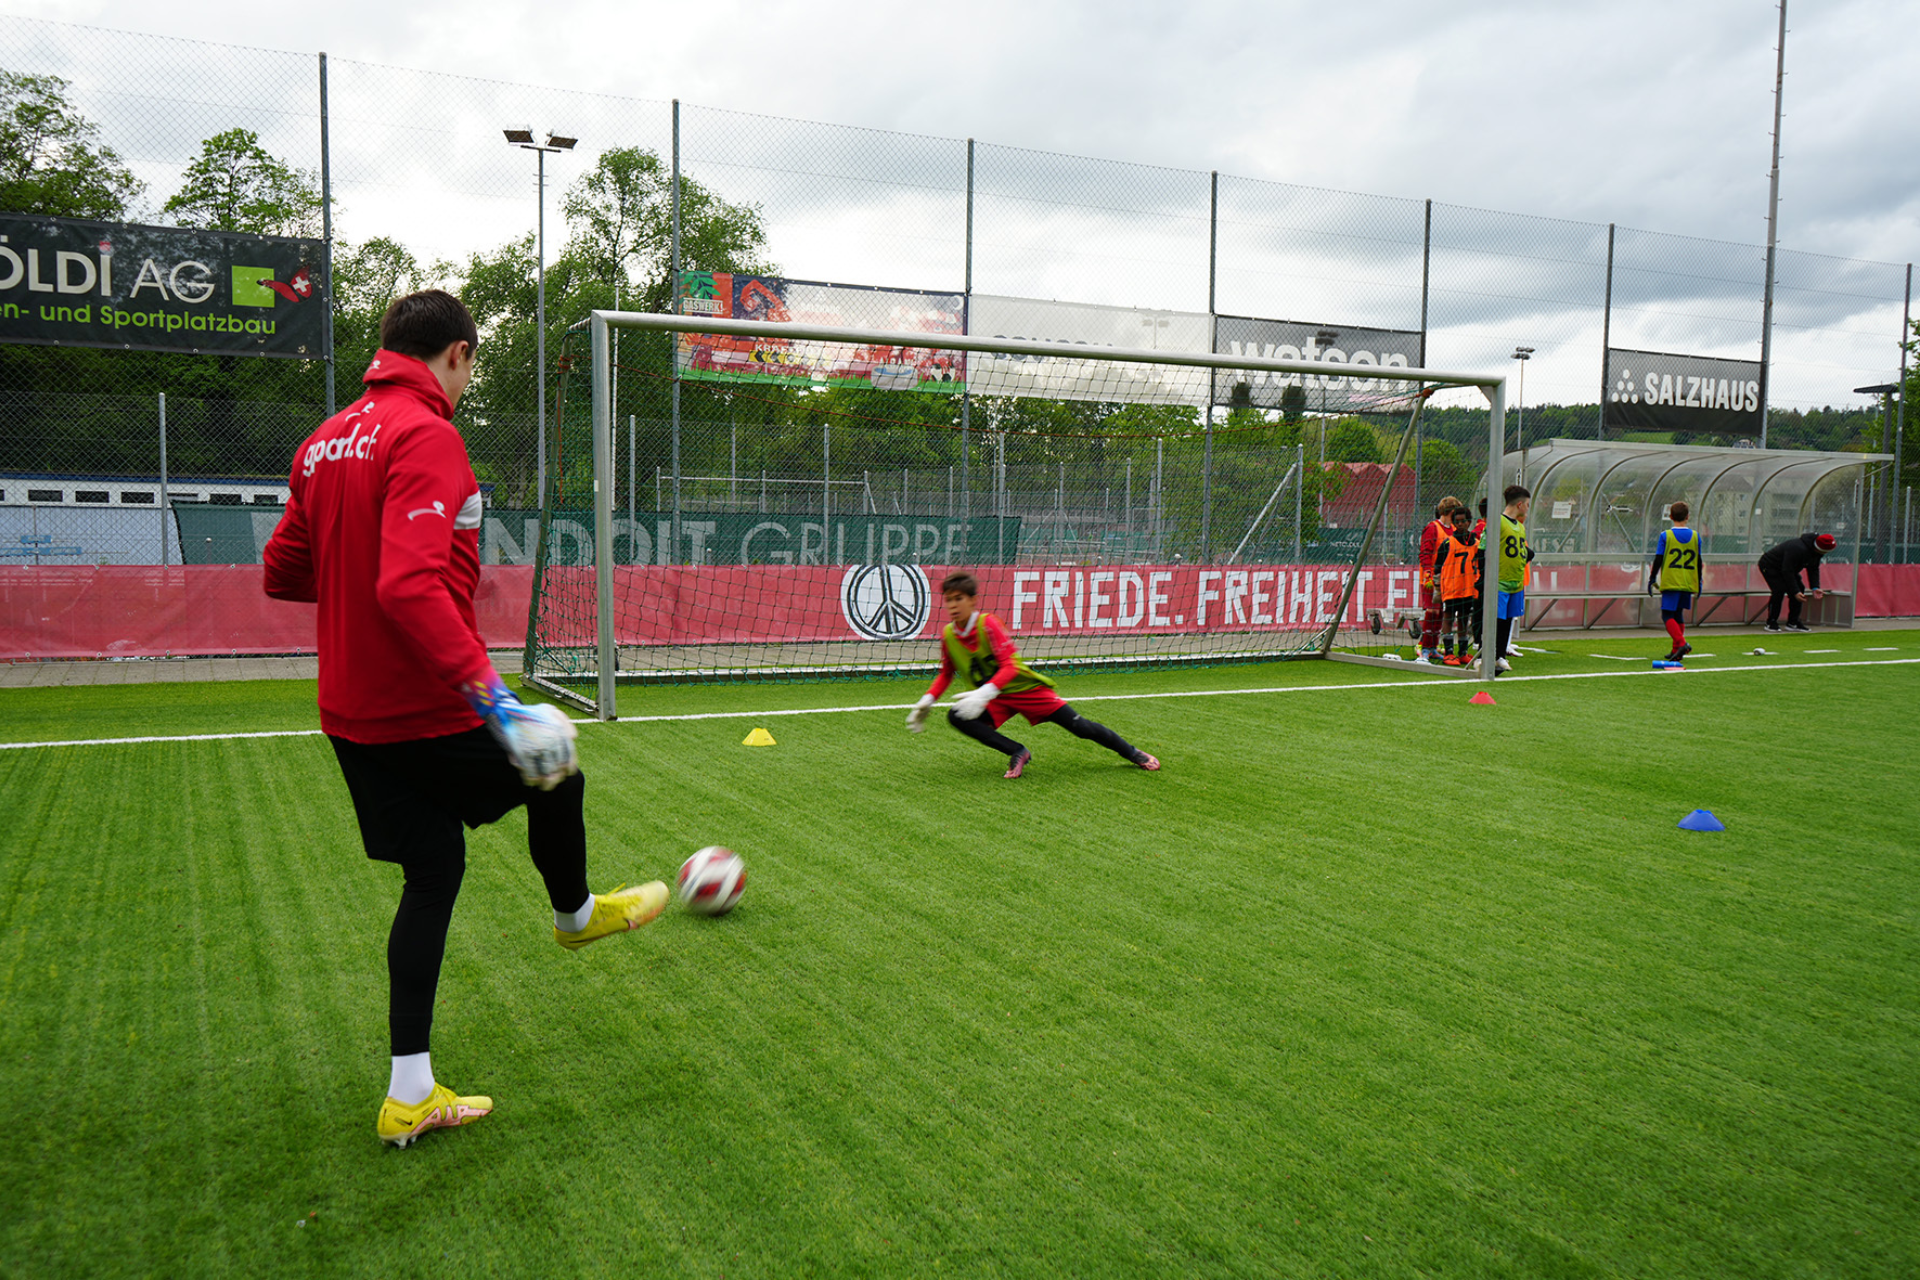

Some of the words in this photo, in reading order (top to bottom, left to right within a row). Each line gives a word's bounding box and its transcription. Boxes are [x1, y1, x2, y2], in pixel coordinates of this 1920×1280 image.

[130, 258, 215, 304] AG
[0, 302, 29, 319] n-
[40, 305, 91, 323] und
[100, 305, 276, 335] Sportplatzbau
[1645, 372, 1760, 412] SALZHAUS
[1505, 535, 1526, 558] 85
[1669, 548, 1696, 570] 22
[1012, 571, 1184, 630] FRIEDE.
